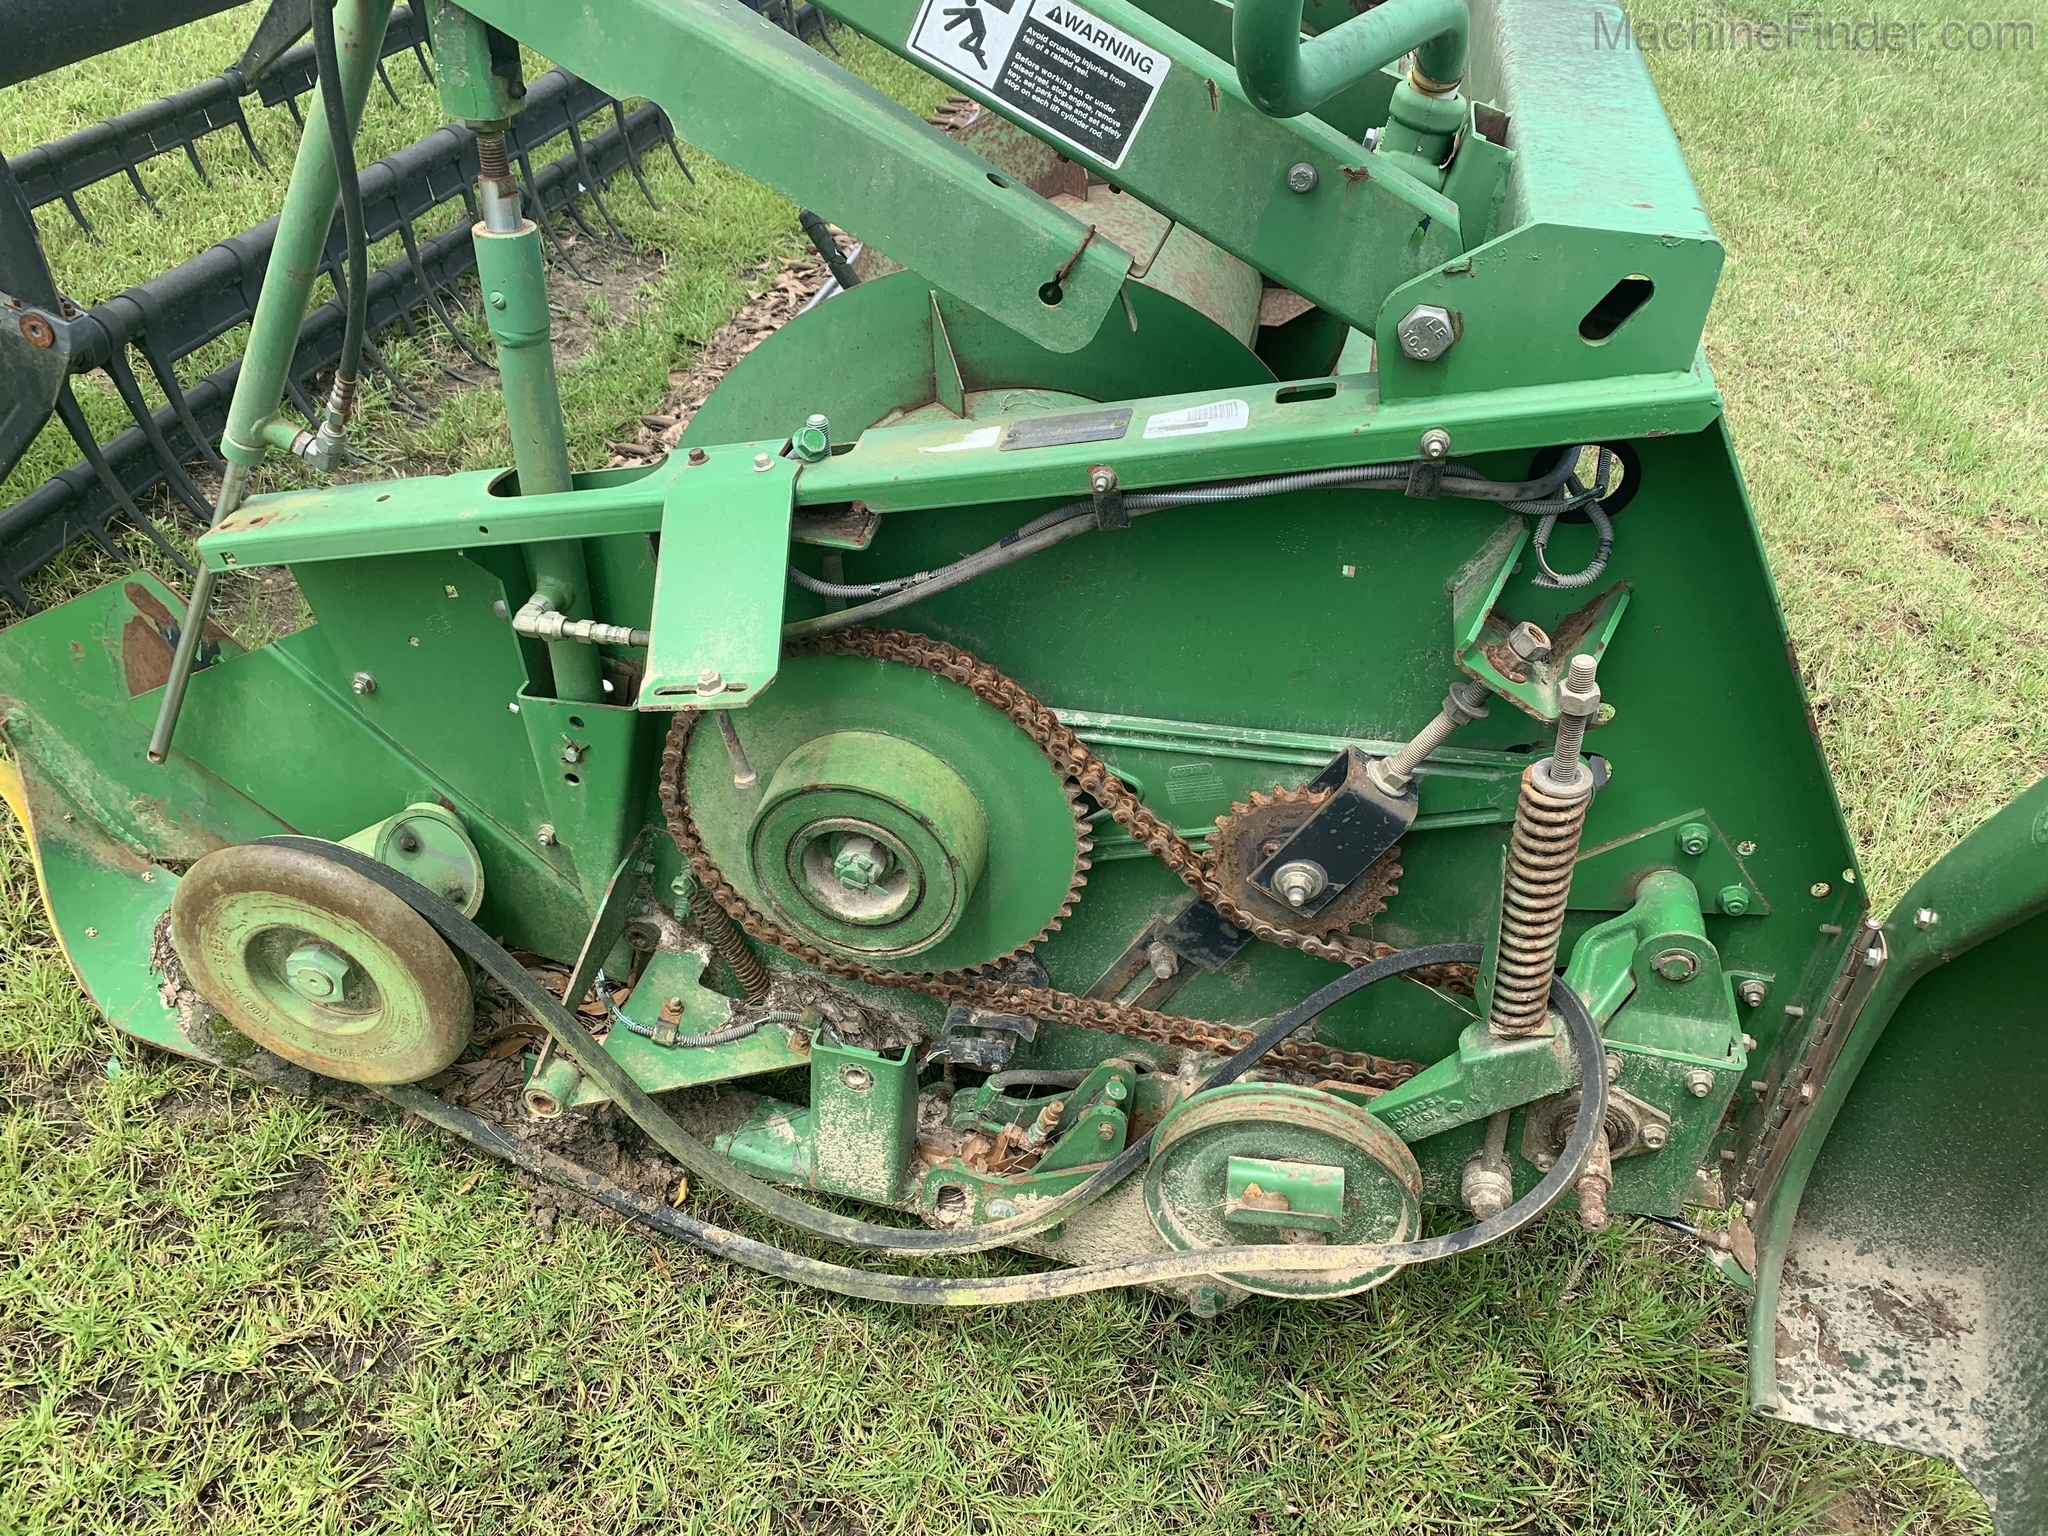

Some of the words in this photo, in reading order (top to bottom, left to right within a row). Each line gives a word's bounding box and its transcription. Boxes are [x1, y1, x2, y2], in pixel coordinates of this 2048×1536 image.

[1022, 34, 1034, 47] fall
[1035, 43, 1044, 51] of
[1050, 51, 1074, 69] raised
[1073, 65, 1089, 78] reel.
[1026, 26, 1049, 43] Avoid
[1048, 40, 1081, 62] crushing
[1081, 57, 1109, 78] injuries
[1108, 73, 1127, 88] from
[1064, 10, 1155, 75] WARNING
[1003, 77, 1020, 91] stop
[1021, 87, 1031, 97] on
[1031, 94, 1049, 107] each
[1049, 105, 1060, 114] lift
[1060, 110, 1089, 130] cylinder
[1089, 126, 1103, 139] rod.
[1007, 68, 1022, 83] key,
[1023, 79, 1035, 89] set
[1035, 86, 1053, 99] park
[1053, 94, 1073, 111] brake
[1073, 106, 1089, 119] and
[1088, 116, 1100, 127] set
[1100, 122, 1122, 139] safety
[1011, 61, 1034, 78] raised
[1034, 75, 1050, 88] reel,
[1051, 83, 1068, 98] stop
[1068, 94, 1093, 113] engine,
[1095, 109, 1121, 128] remove
[1015, 51, 1040, 71] Before
[1041, 68, 1073, 91] working
[1073, 86, 1084, 97] on
[1085, 93, 1094, 101] or
[1094, 97, 1116, 114] under
[1403, 329, 1430, 358] 10.9
[1426, 318, 1448, 340] LE
